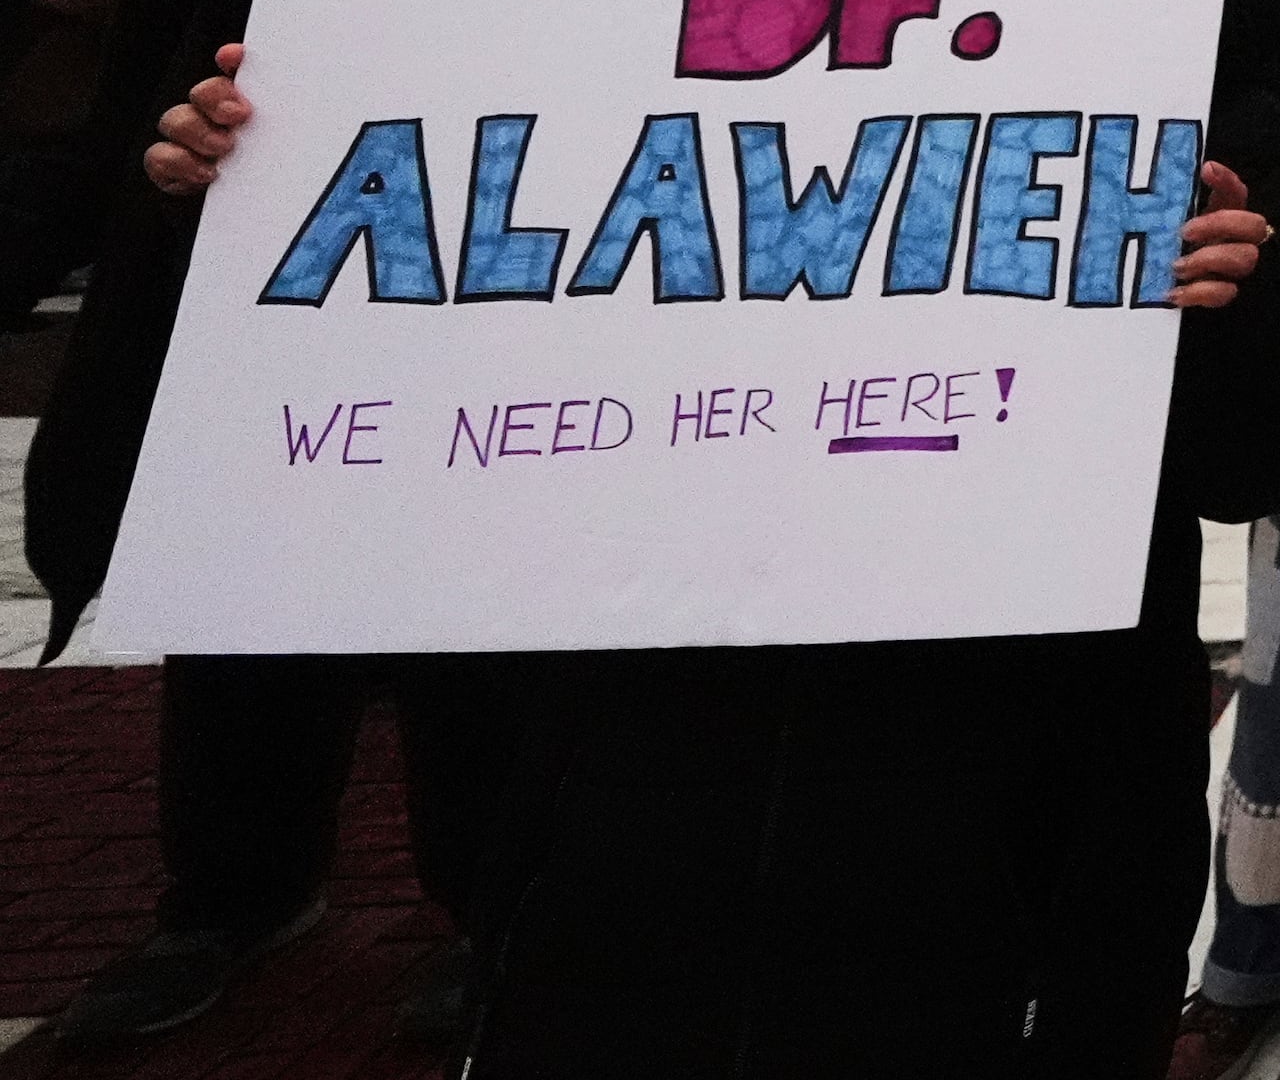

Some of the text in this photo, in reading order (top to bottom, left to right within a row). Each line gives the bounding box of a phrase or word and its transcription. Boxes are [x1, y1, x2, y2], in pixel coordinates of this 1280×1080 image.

[257, 112, 1203, 309] ALAWIEH
[283, 400, 393, 468] WE
[447, 396, 634, 469] NEED
[670, 388, 777, 447] HER
